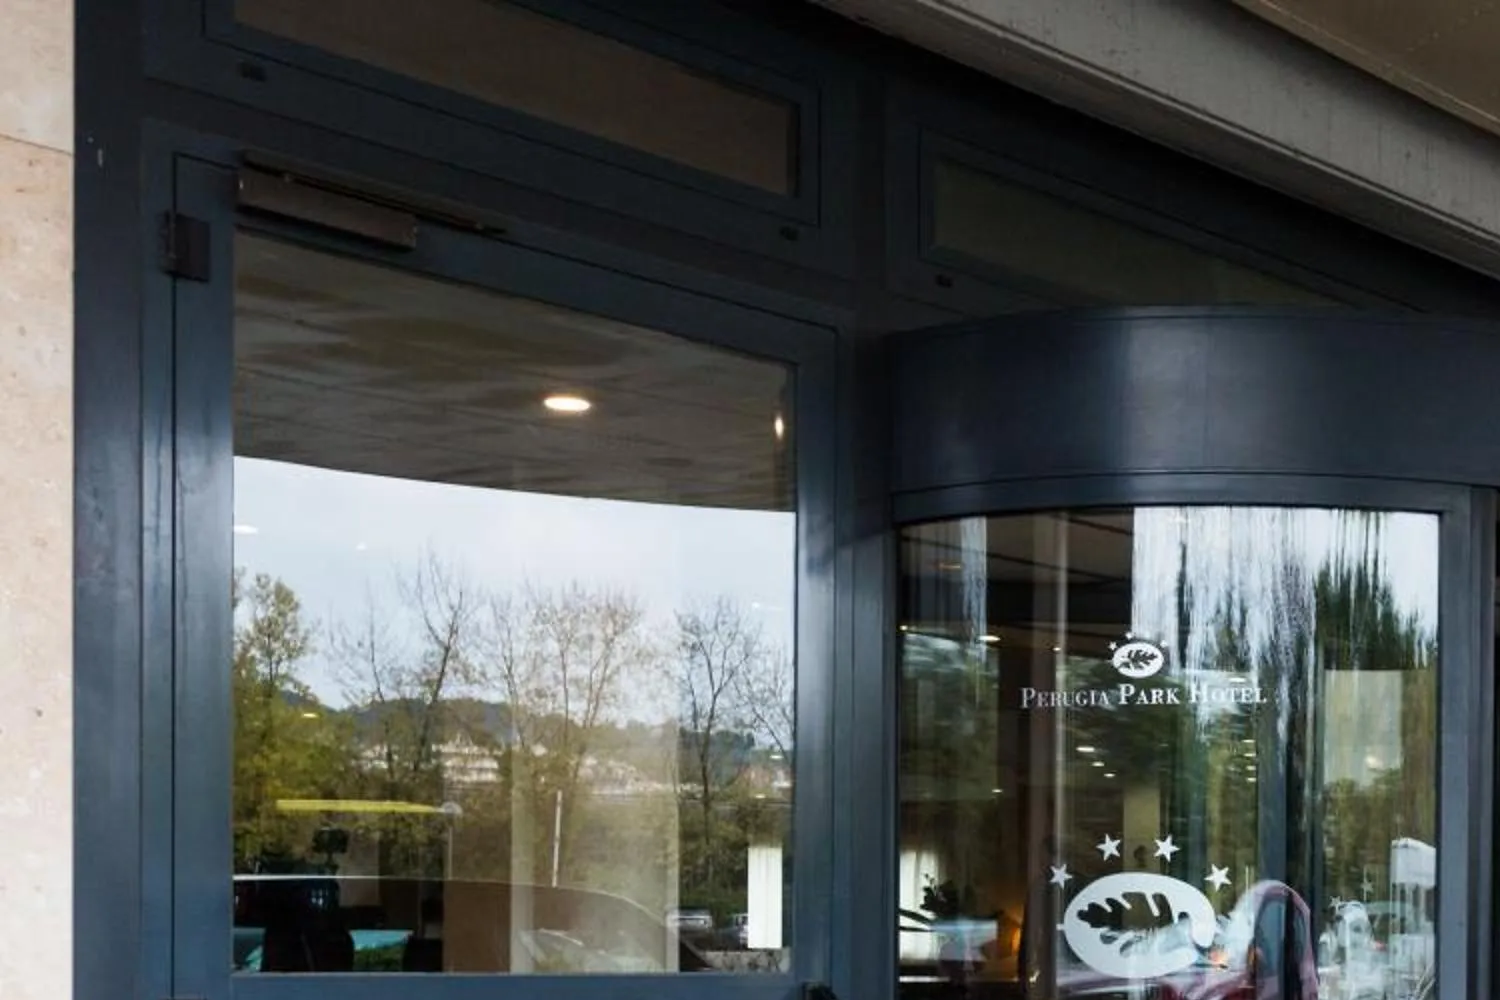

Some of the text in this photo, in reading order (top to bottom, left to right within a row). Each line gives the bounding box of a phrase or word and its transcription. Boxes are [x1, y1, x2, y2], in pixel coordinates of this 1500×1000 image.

[1021, 683, 1267, 709] PERUGIA PARK HOTEL
